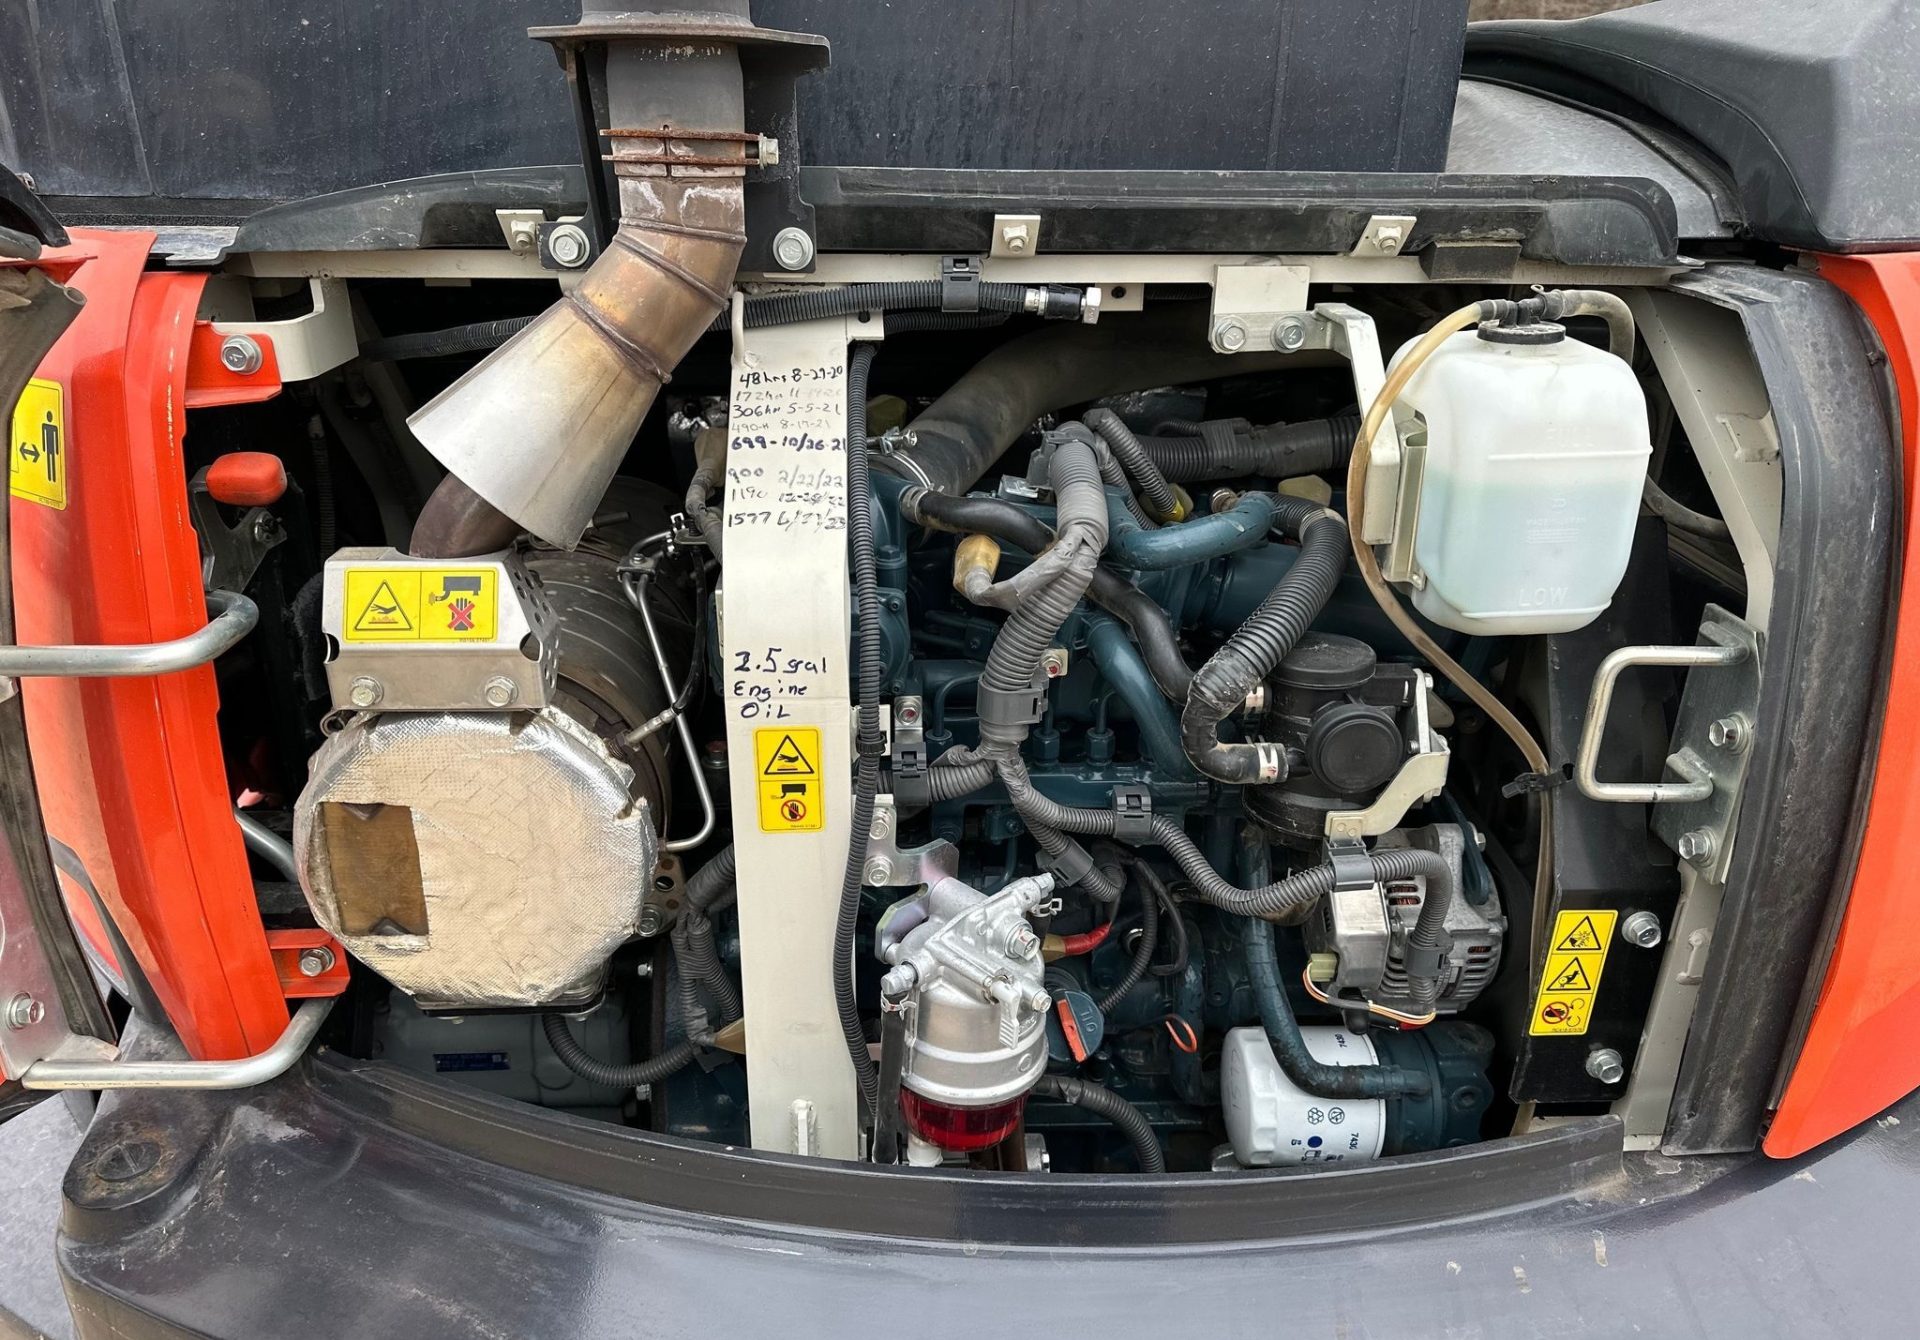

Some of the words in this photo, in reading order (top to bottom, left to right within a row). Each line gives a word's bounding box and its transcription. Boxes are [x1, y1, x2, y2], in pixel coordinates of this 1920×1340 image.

[787, 402, 841, 415] 5-5-21
[728, 468, 764, 483] 900
[778, 464, 843, 489] 2/22/22
[728, 511, 771, 527] 1577
[1518, 586, 1569, 608] LOW
[734, 648, 782, 673] 2.5
[783, 657, 827, 674] gal
[734, 680, 808, 702] Engine
[1080, 1006, 1098, 1033] OIL
